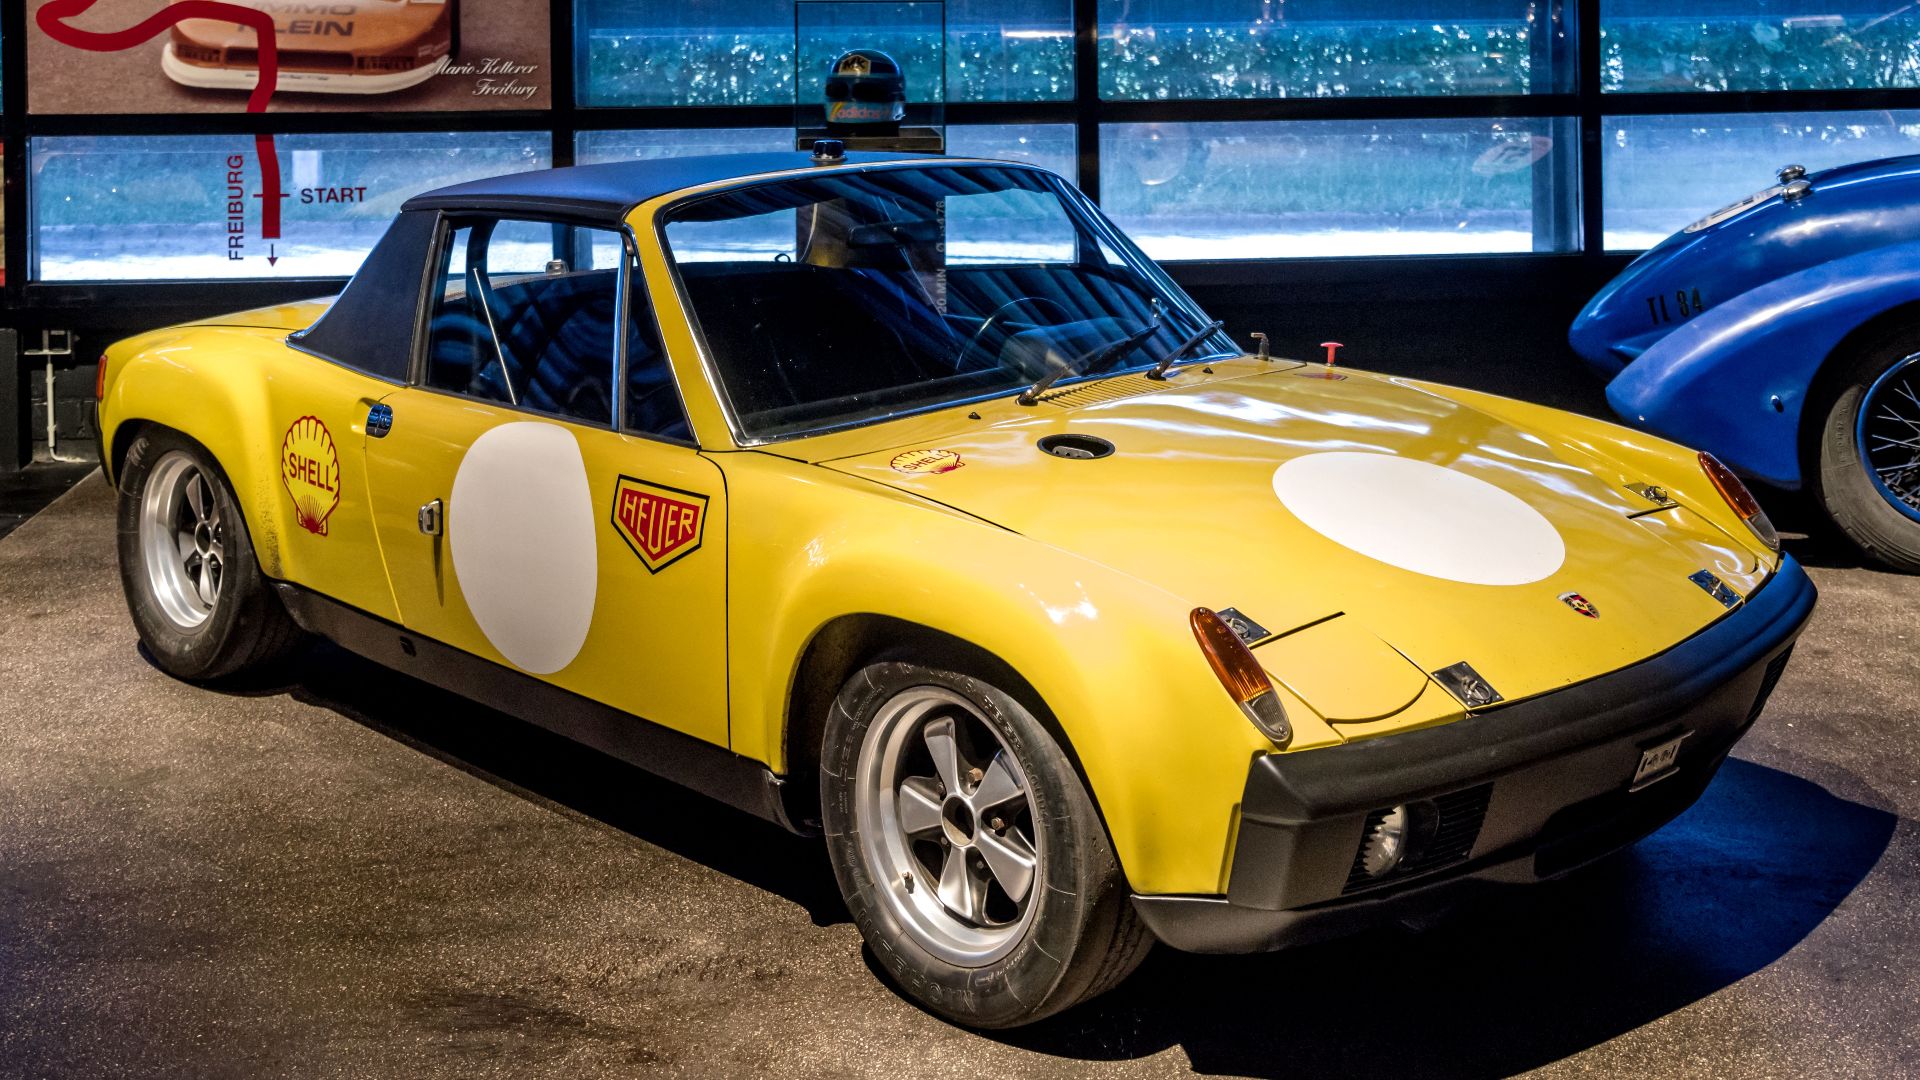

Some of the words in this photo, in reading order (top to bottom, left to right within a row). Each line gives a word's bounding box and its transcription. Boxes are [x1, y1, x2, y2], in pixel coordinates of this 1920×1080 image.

[429, 57, 475, 75] Mario
[472, 78, 538, 100] Freiburg
[300, 187, 367, 204] START
[227, 154, 244, 261] FREIBURG
[289, 452, 334, 492] SHELL
[903, 453, 952, 471] SHELL
[622, 493, 695, 555] HEUER
